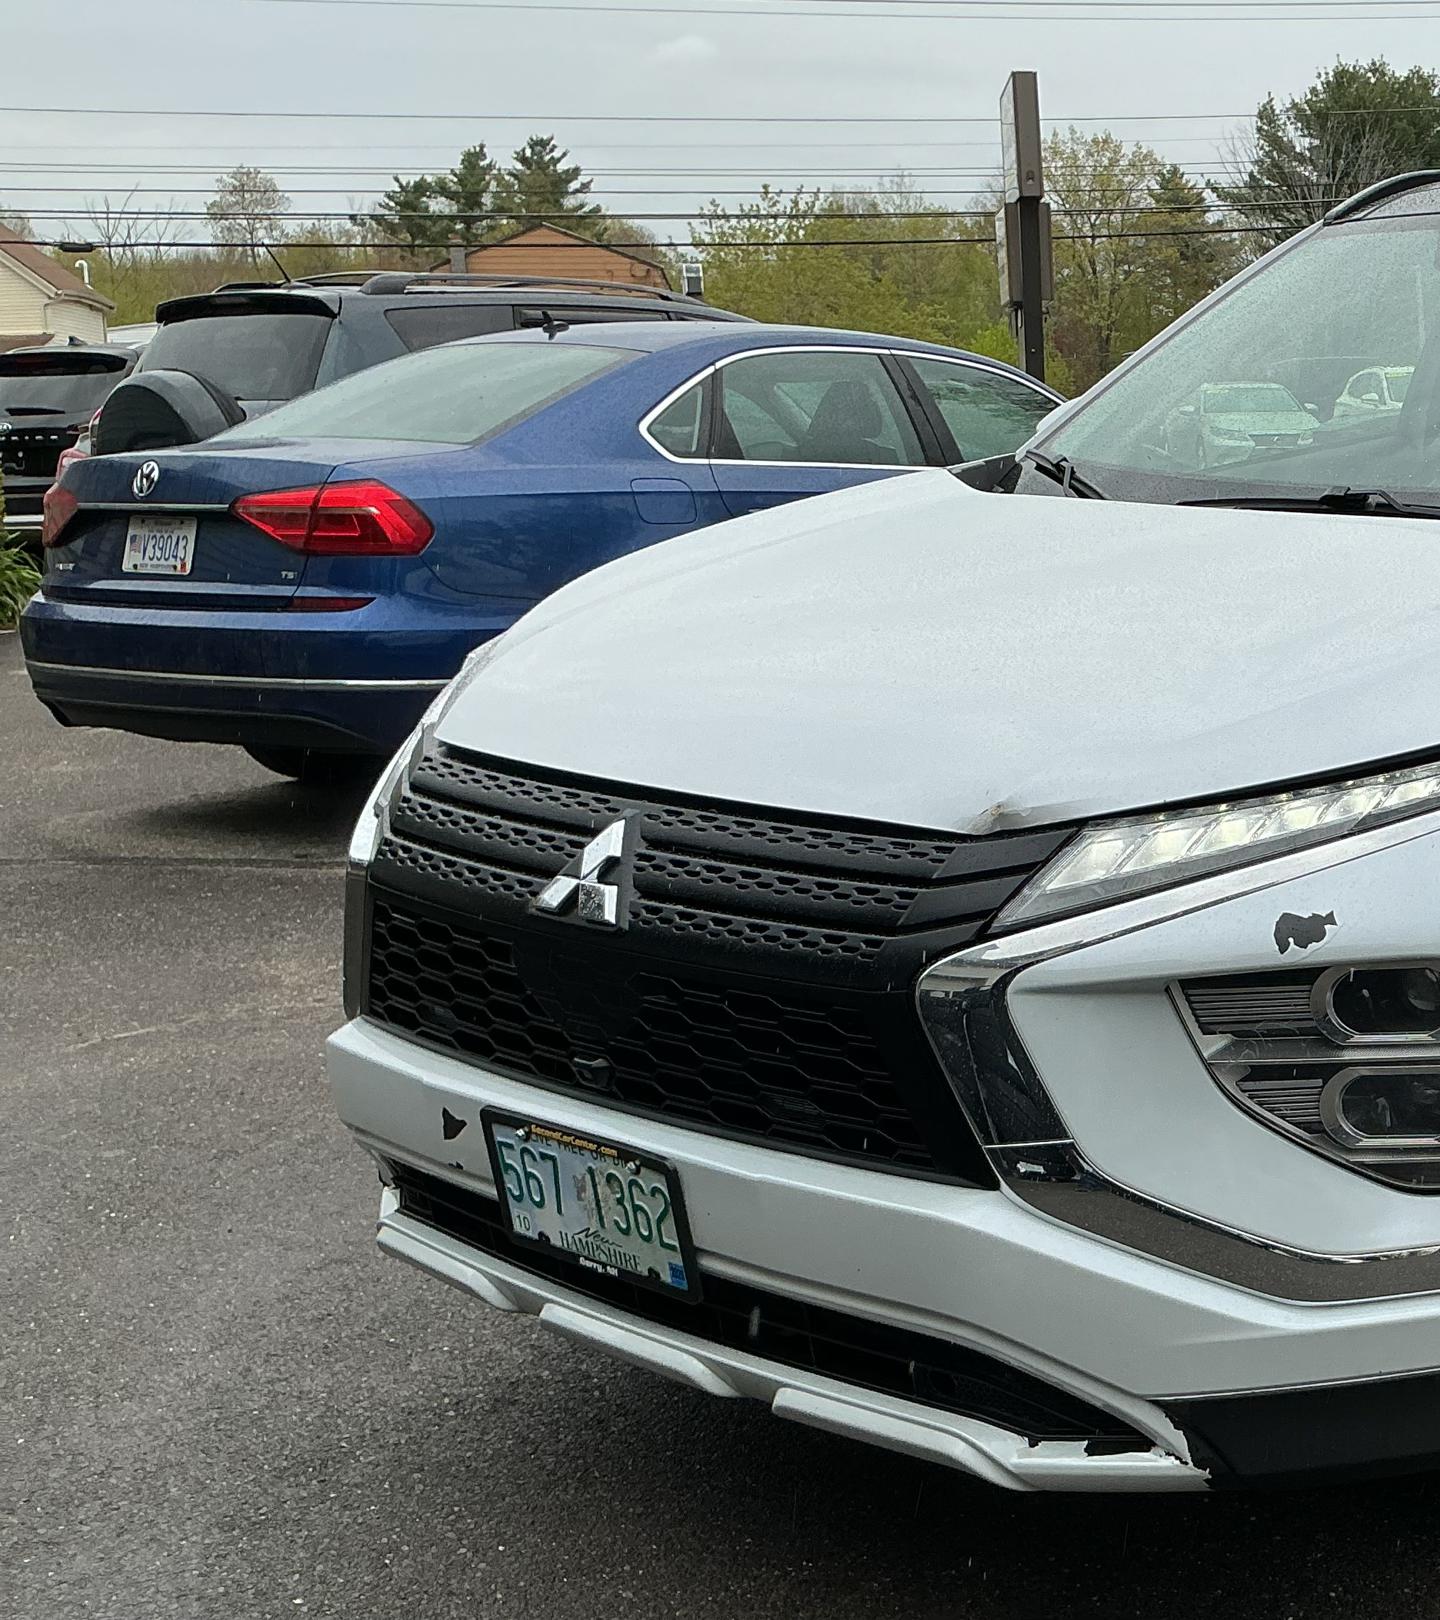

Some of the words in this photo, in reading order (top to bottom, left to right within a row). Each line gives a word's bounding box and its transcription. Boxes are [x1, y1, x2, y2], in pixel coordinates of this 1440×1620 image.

[142, 534, 188, 561] V39043
[497, 1138, 564, 1216] 567
[586, 1165, 679, 1251] 1362
[516, 1214, 531, 1231] 10
[573, 1226, 623, 1247] New
[559, 1230, 642, 1271] HAMPSHIRE
